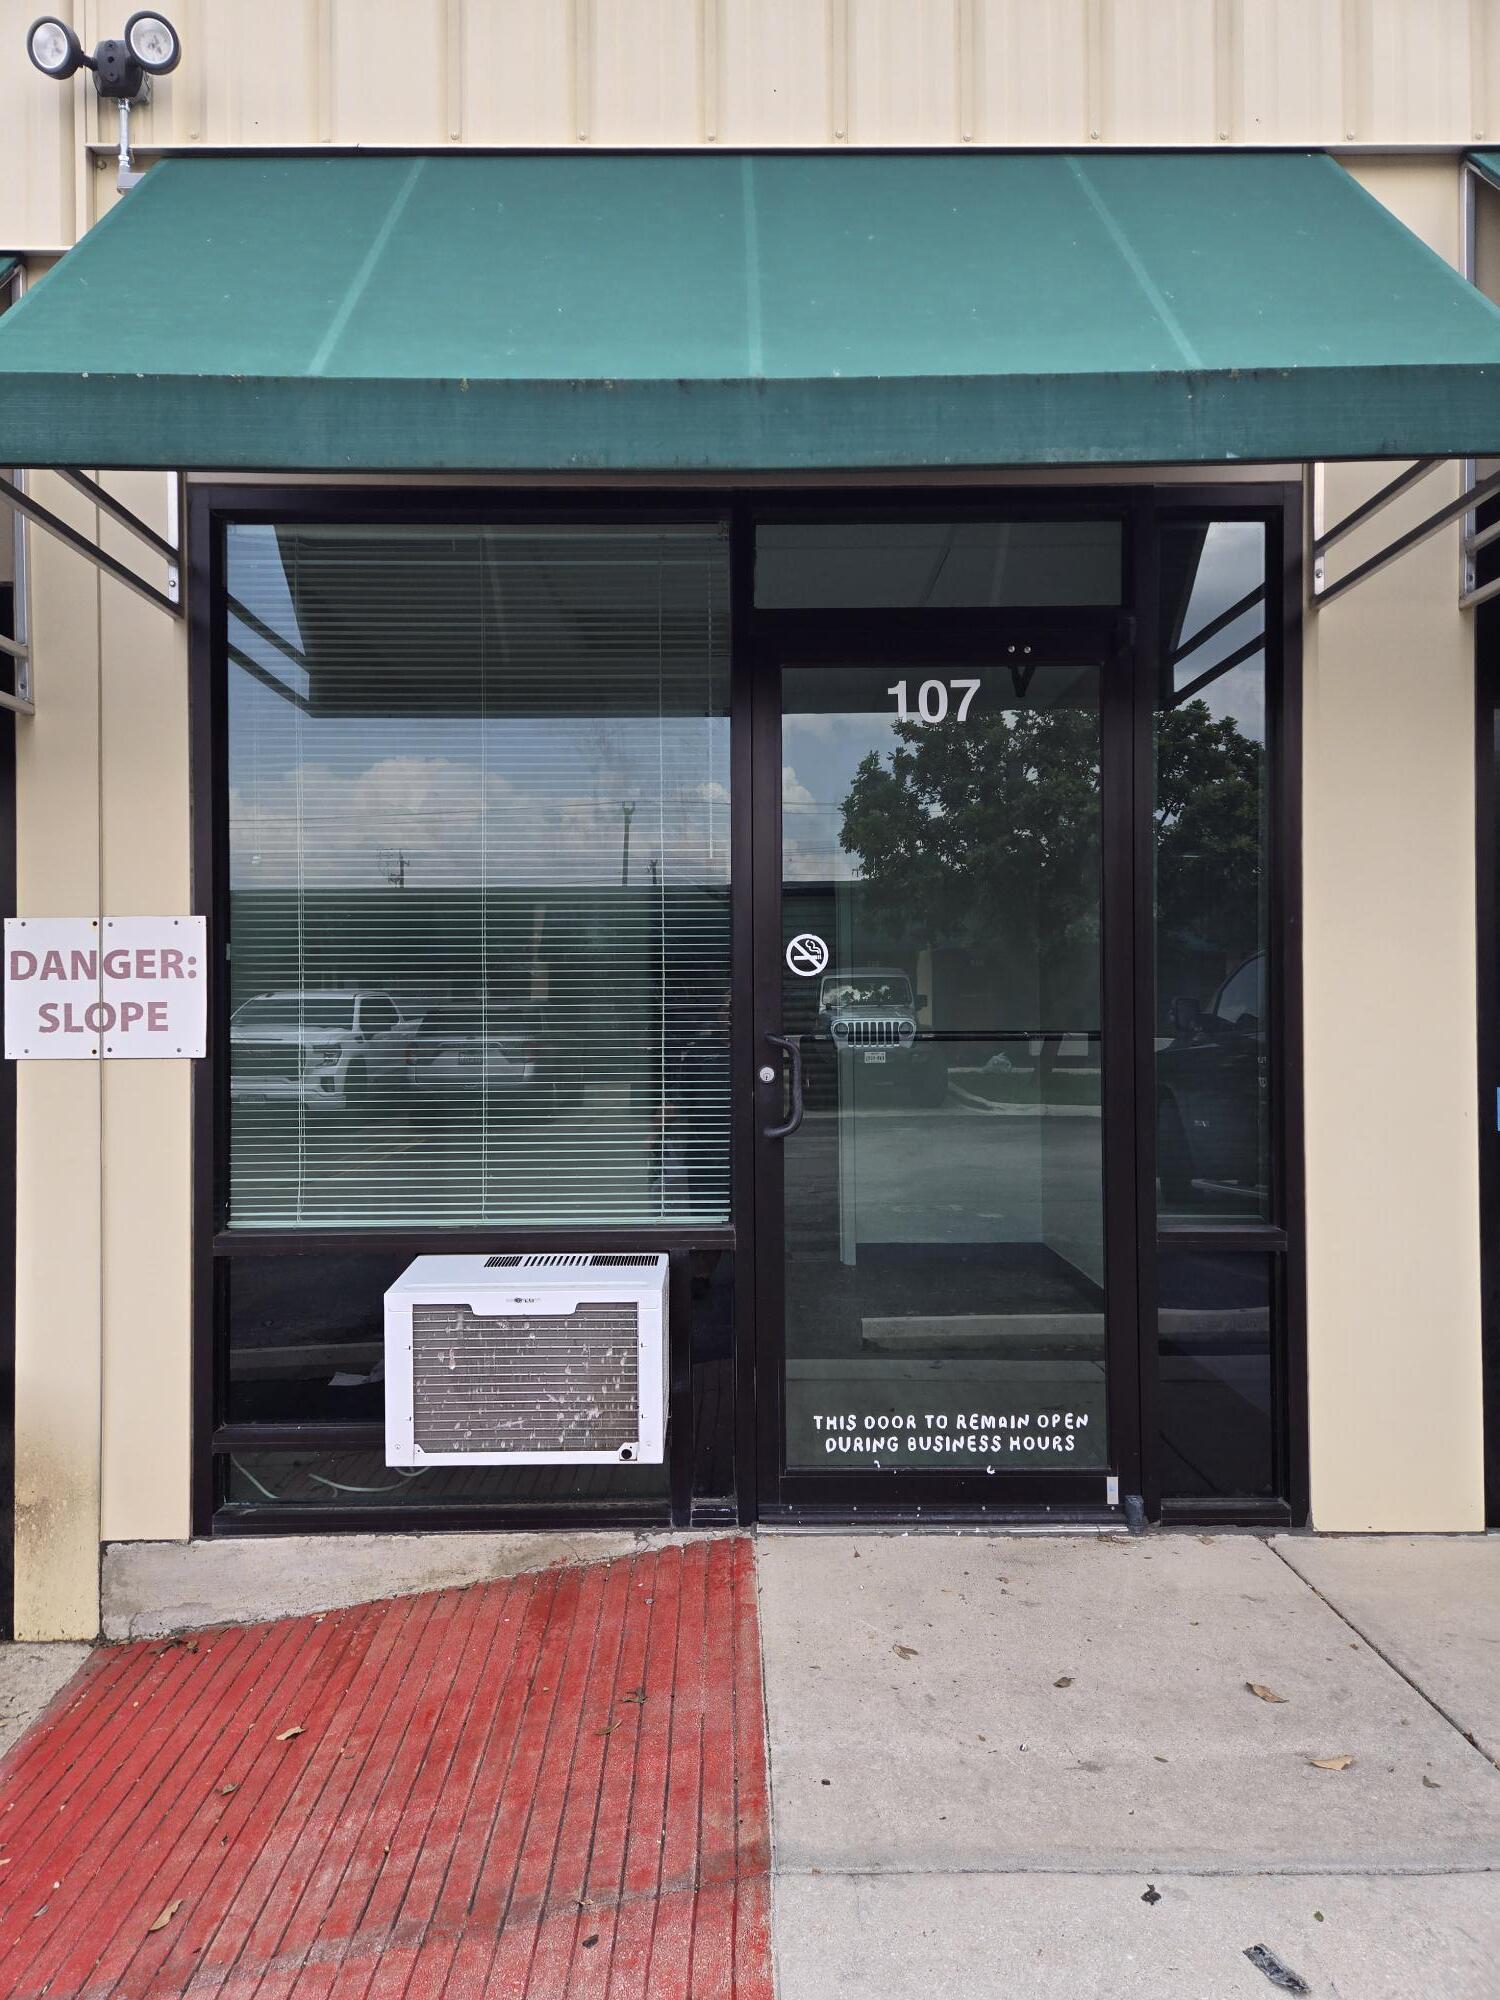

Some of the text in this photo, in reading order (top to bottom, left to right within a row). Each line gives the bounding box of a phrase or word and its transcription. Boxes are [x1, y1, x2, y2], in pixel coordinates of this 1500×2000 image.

[886, 679, 981, 724] 107
[10, 949, 197, 981] DANGER:
[38, 1002, 169, 1033] SLOPE
[813, 1412, 1089, 1431] THIS DOOR TO REMAIN OPEN
[825, 1434, 1075, 1453] DURING BUSINESS HOURS
